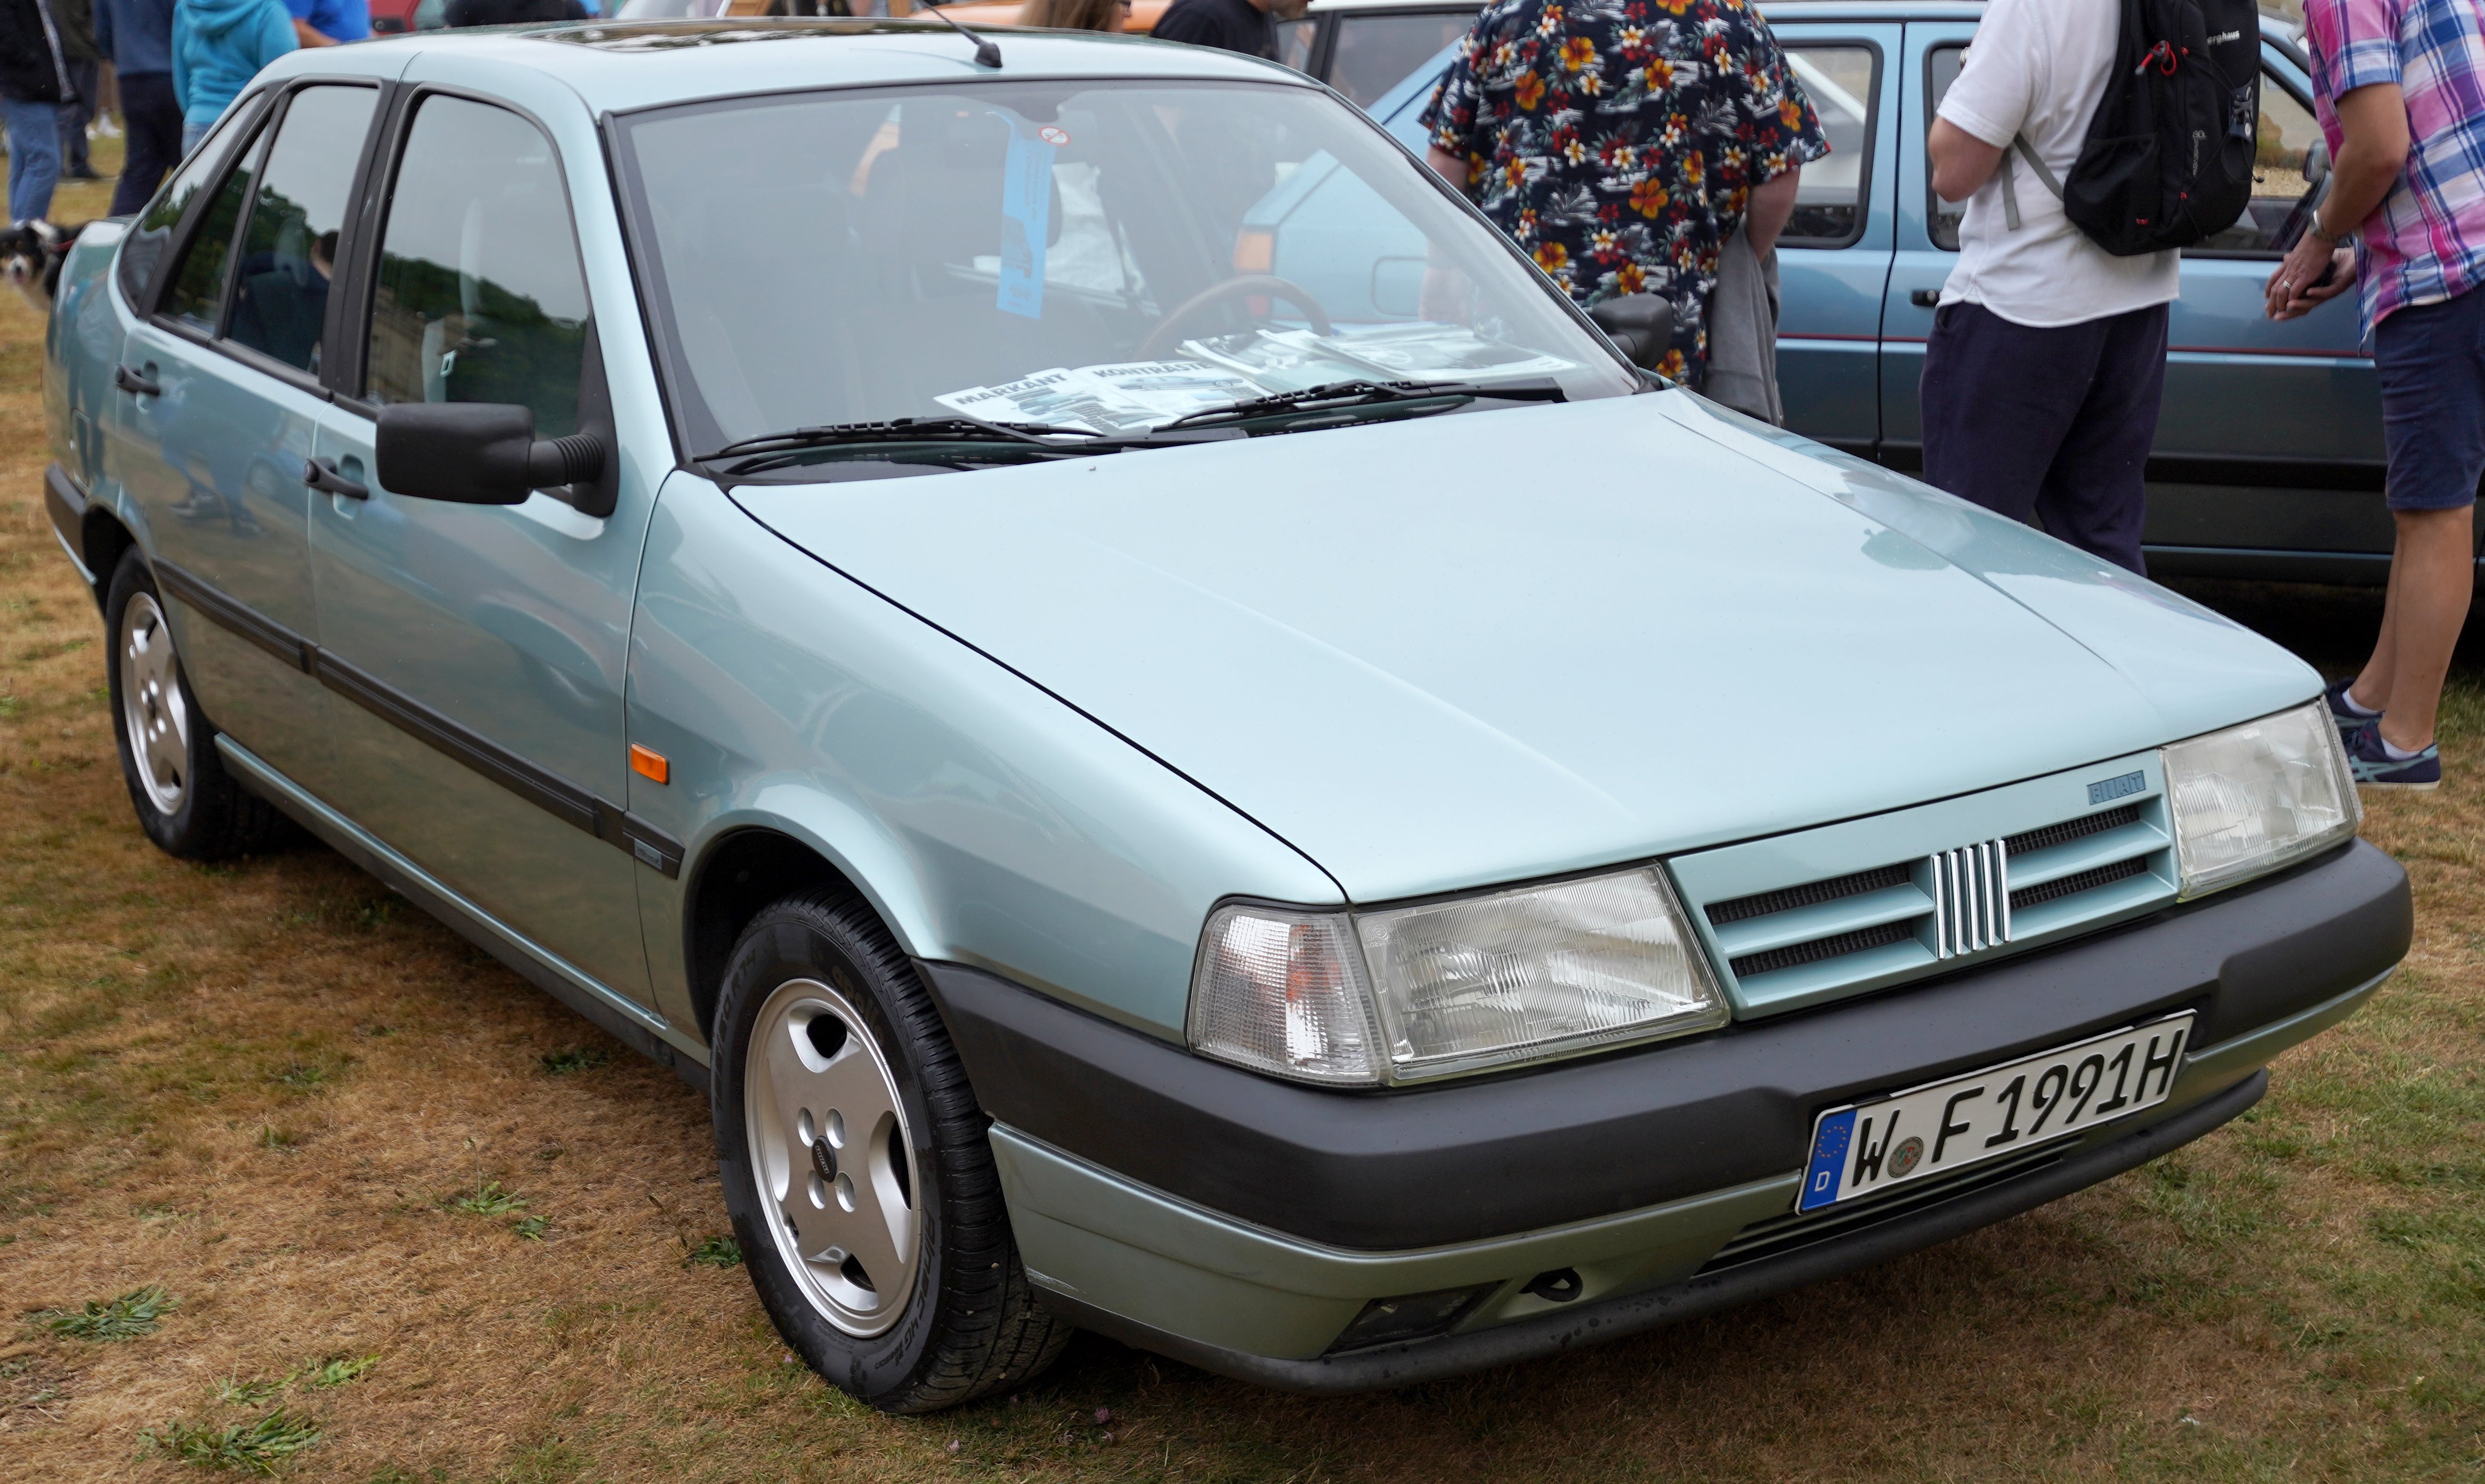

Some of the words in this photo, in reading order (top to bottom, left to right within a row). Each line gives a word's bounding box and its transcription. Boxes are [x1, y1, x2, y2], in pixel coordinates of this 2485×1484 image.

[2207, 30, 2240, 45] erghaus
[1091, 362, 1211, 377] KONTRASTE
[954, 373, 1067, 404] MARKANT
[2090, 775, 2142, 804] FIAT
[1815, 1171, 1830, 1193] D
[1851, 1109, 1900, 1187] W
